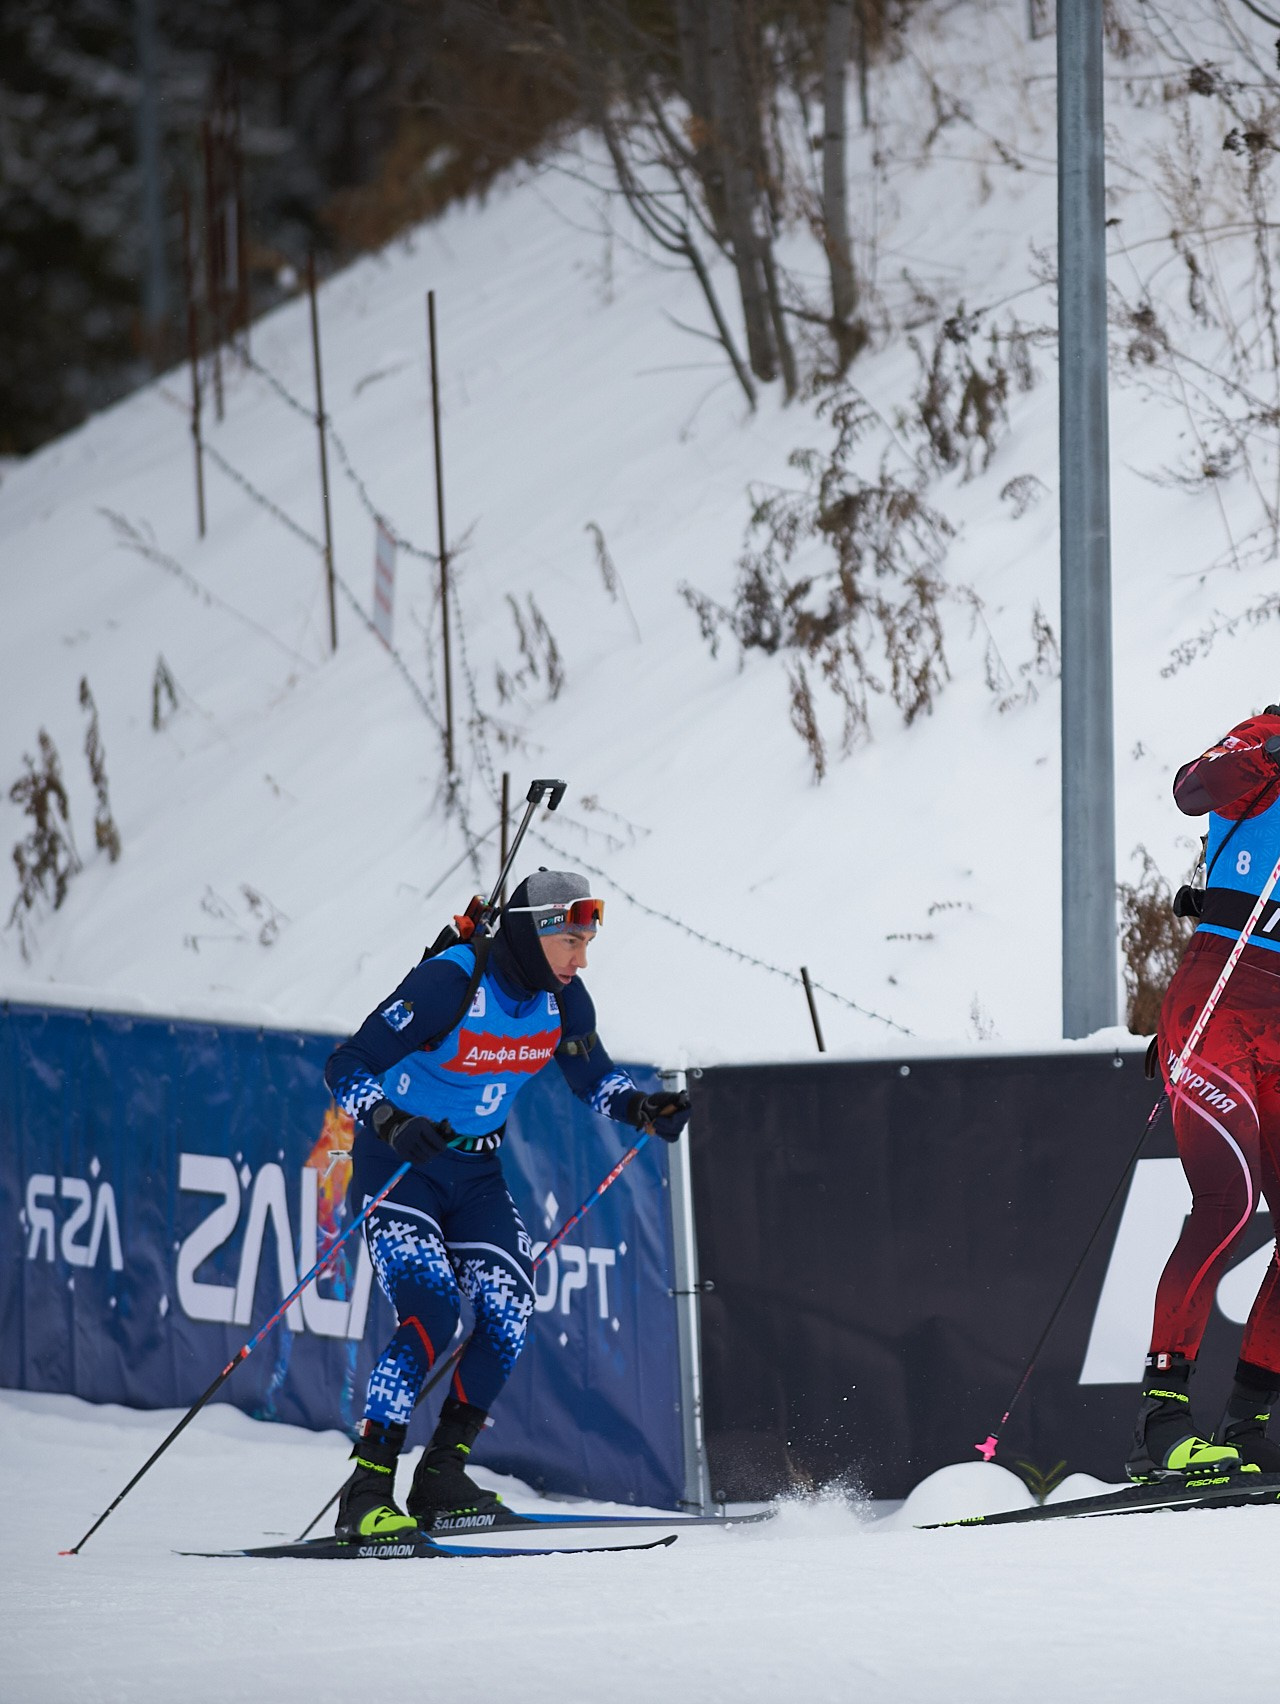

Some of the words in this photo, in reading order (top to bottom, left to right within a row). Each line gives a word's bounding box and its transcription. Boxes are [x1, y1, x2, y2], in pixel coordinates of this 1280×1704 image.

[1236, 850, 1251, 875] 8
[541, 915, 564, 927] PARI
[462, 1046, 516, 1067] Альфа
[518, 1045, 552, 1061] Банк
[397, 1073, 411, 1095] 9
[475, 1083, 507, 1116] 9
[1185, 1476, 1231, 1488] FISCHER
[432, 1514, 496, 1531] SALOMON
[357, 1544, 416, 1557] SALOMON
